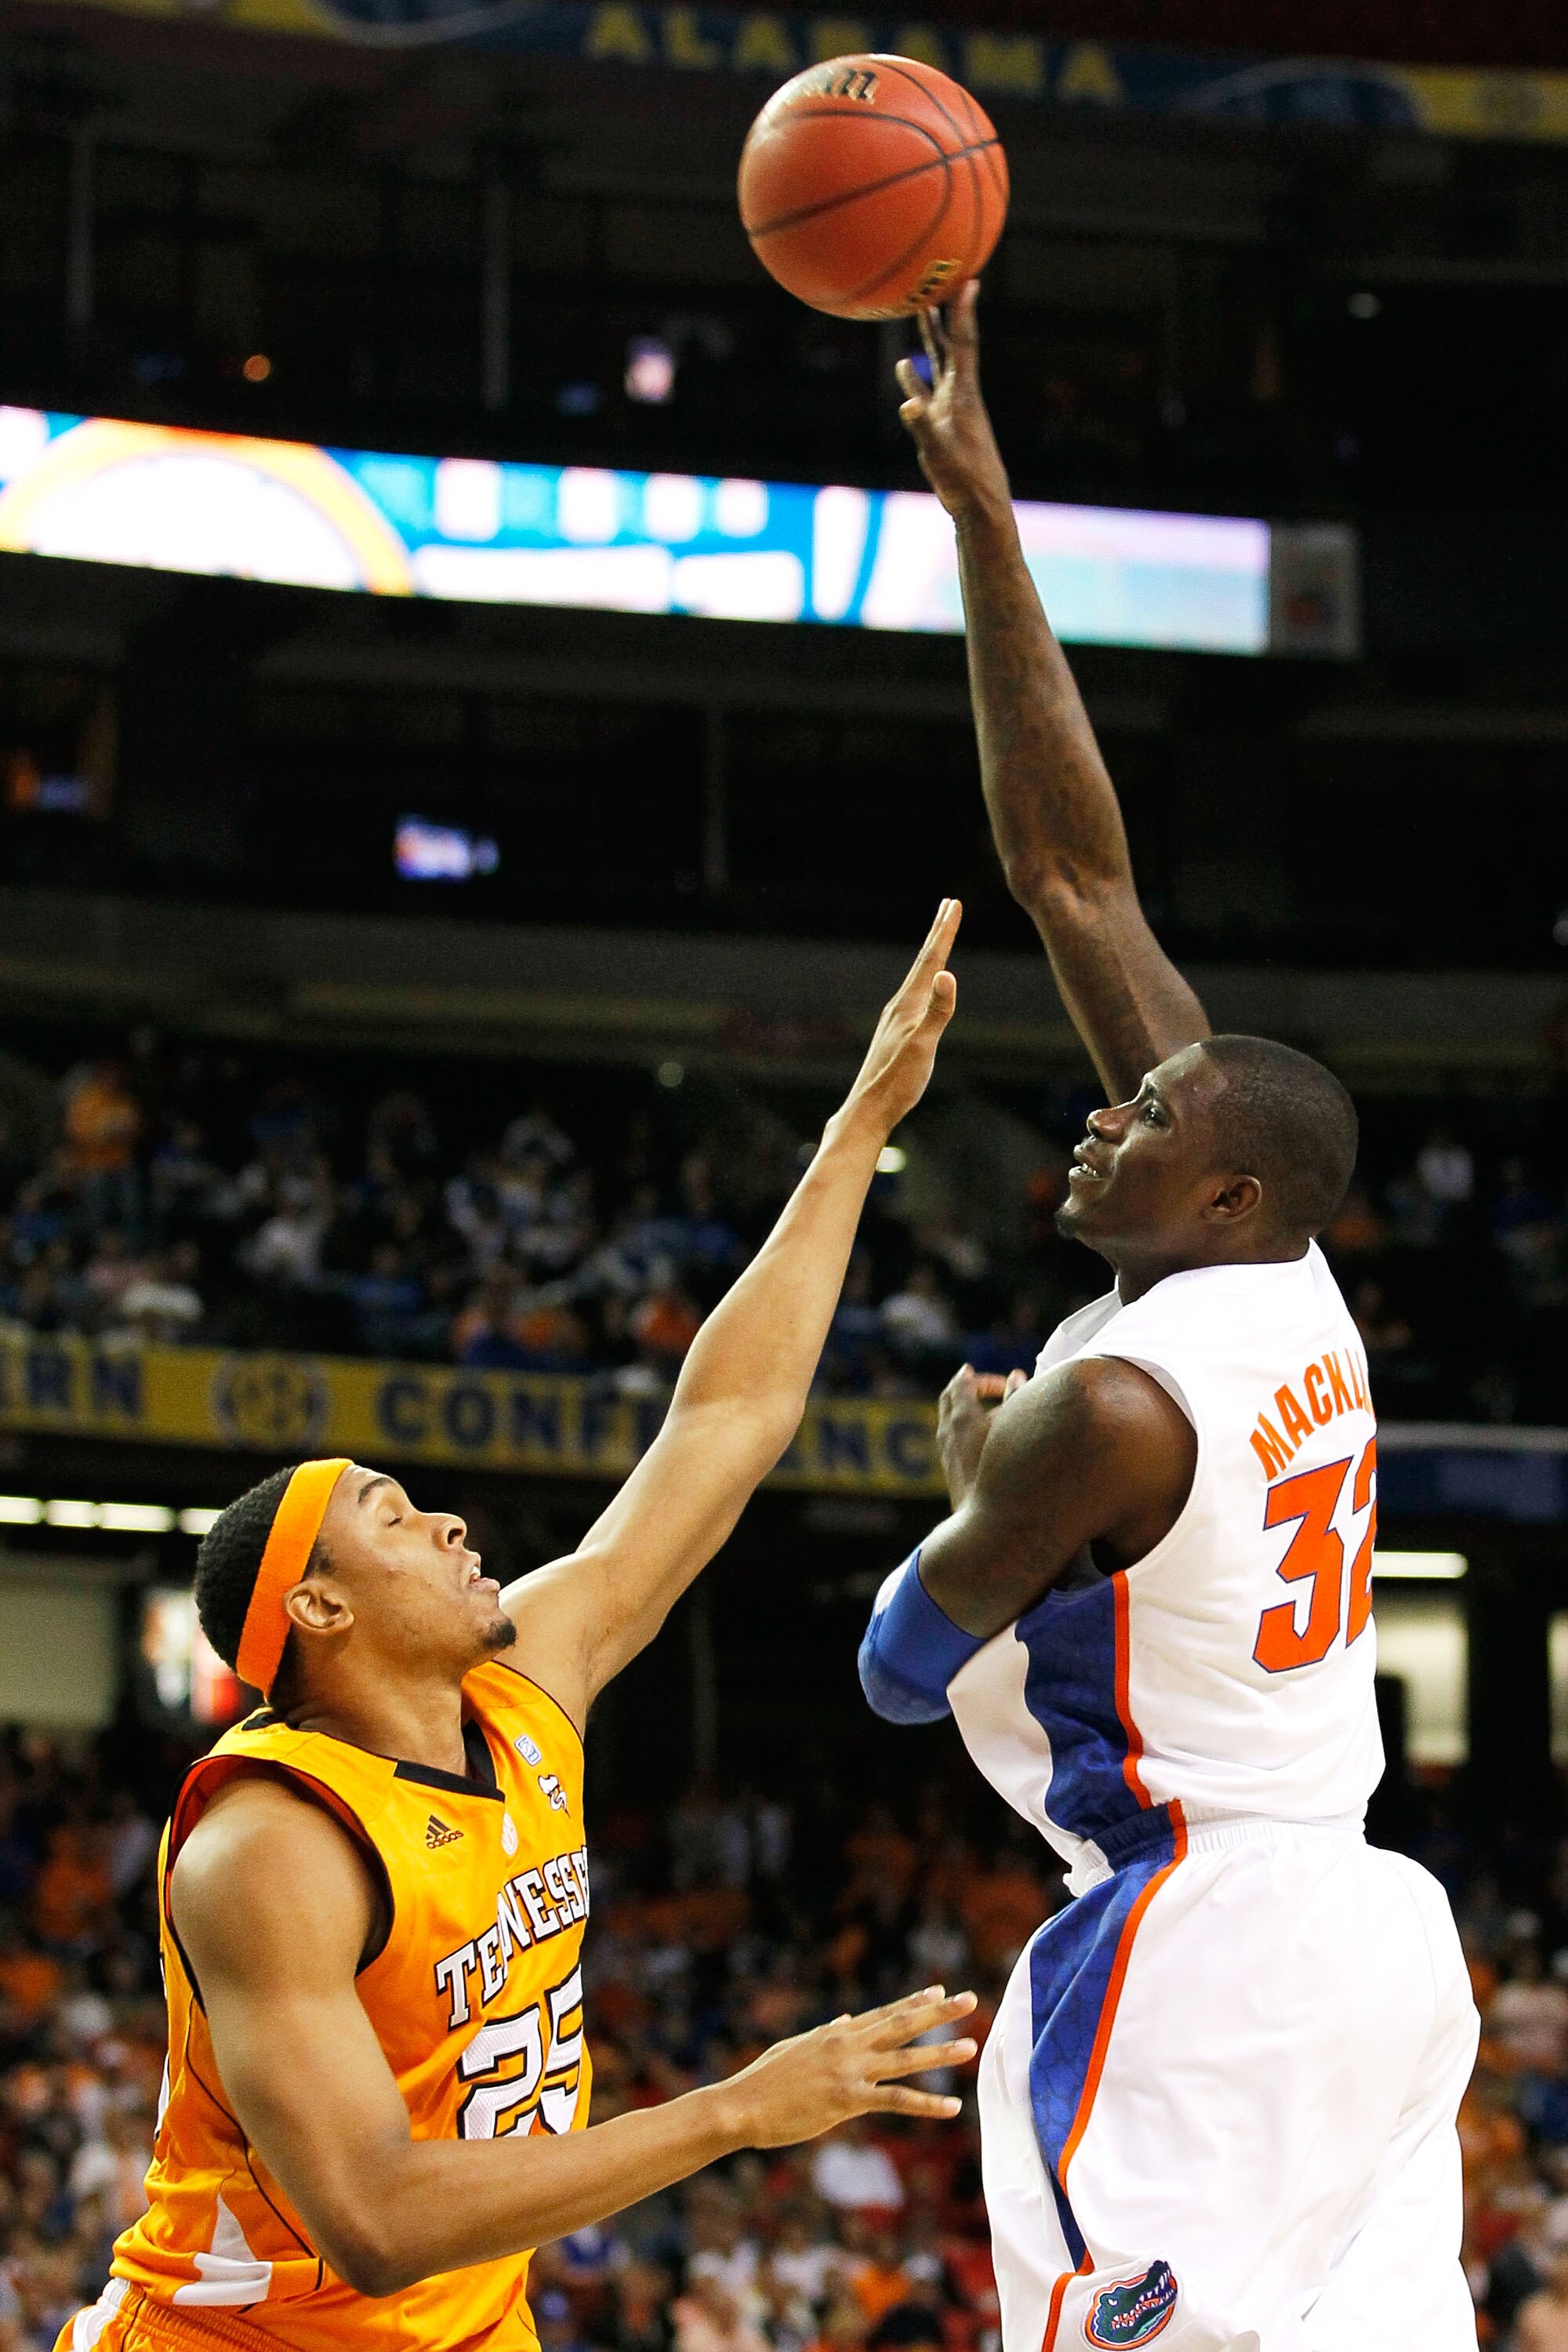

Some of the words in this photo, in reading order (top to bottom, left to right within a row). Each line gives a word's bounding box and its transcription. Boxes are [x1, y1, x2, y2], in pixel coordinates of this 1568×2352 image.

[1253, 1436, 1377, 1674] 32
[426, 1831, 464, 1849] adidas
[456, 1962, 583, 2140] 25
